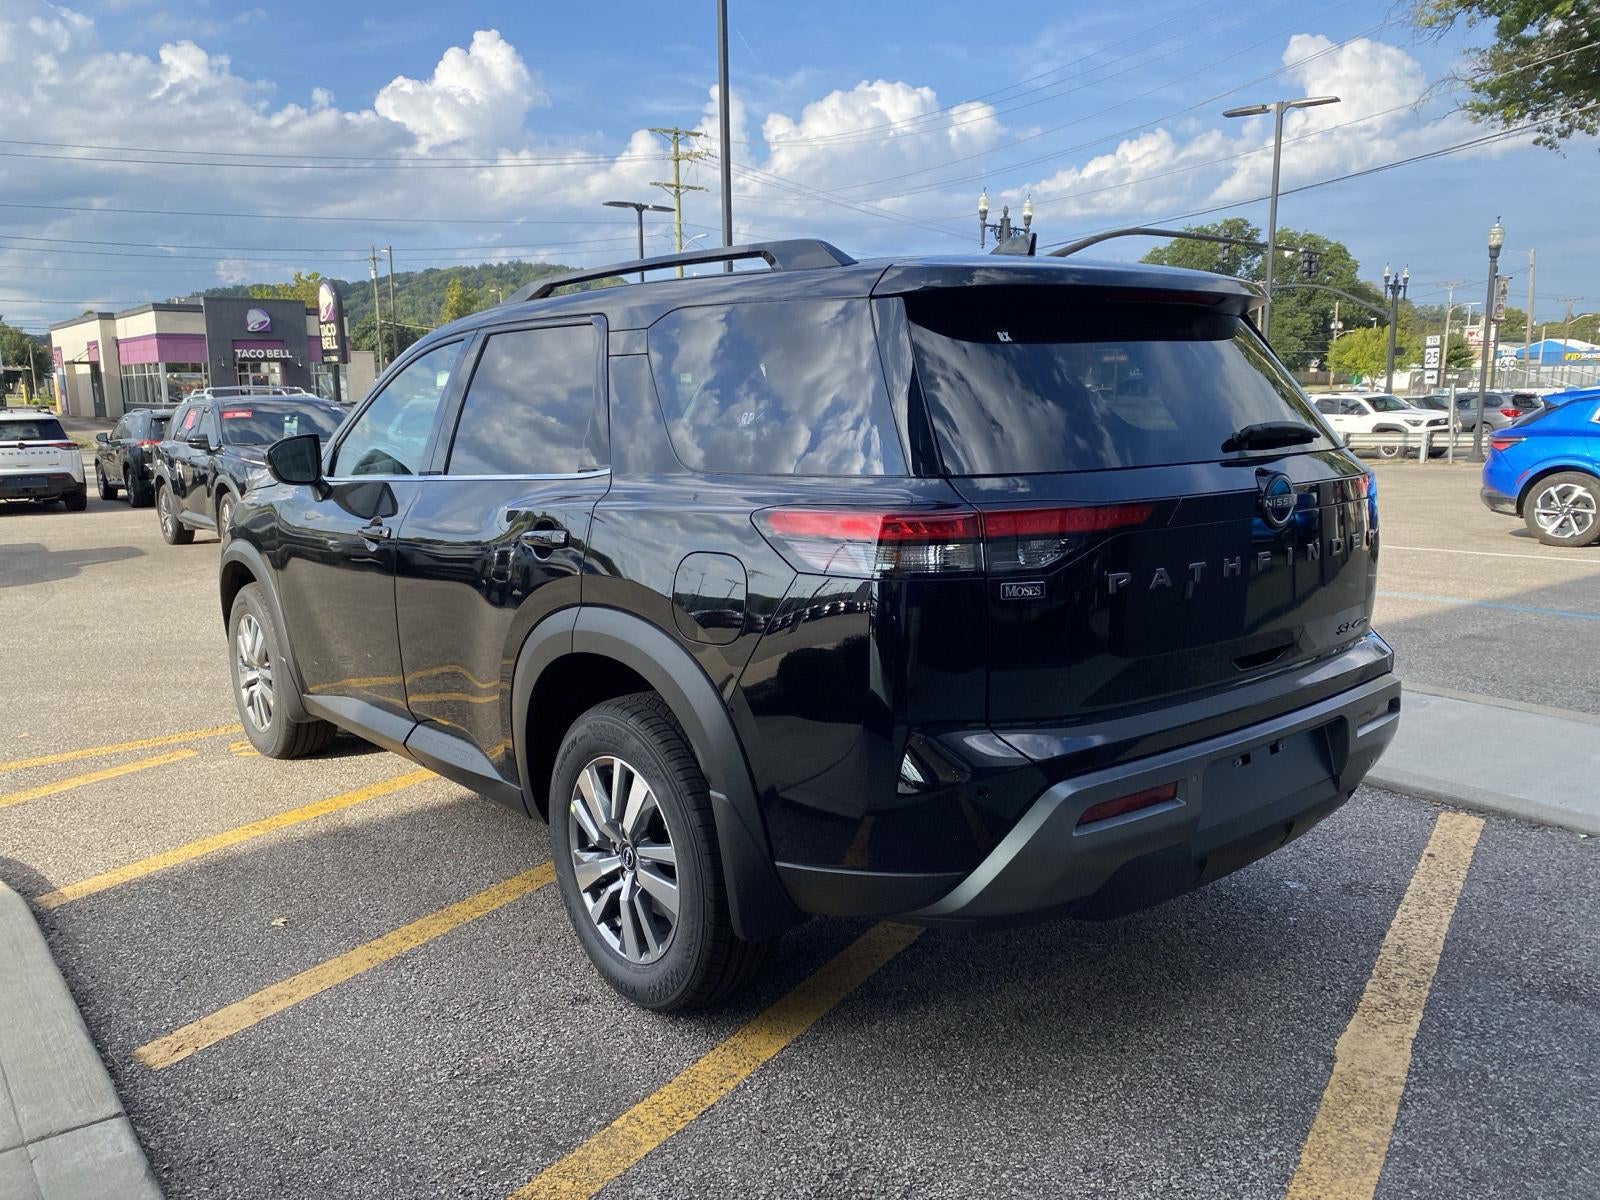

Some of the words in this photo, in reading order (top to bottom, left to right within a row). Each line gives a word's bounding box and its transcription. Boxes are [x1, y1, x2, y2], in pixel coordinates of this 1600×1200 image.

[319, 323, 336, 337] TACO
[321, 337, 338, 350] BELL
[235, 349, 264, 358] TACO
[266, 349, 292, 358] BELL
[1425, 351, 1439, 364] 25
[1500, 358, 1516, 369] 60
[1107, 528, 1376, 595] PATHFINDER
[1005, 585, 1042, 598] MOSES
